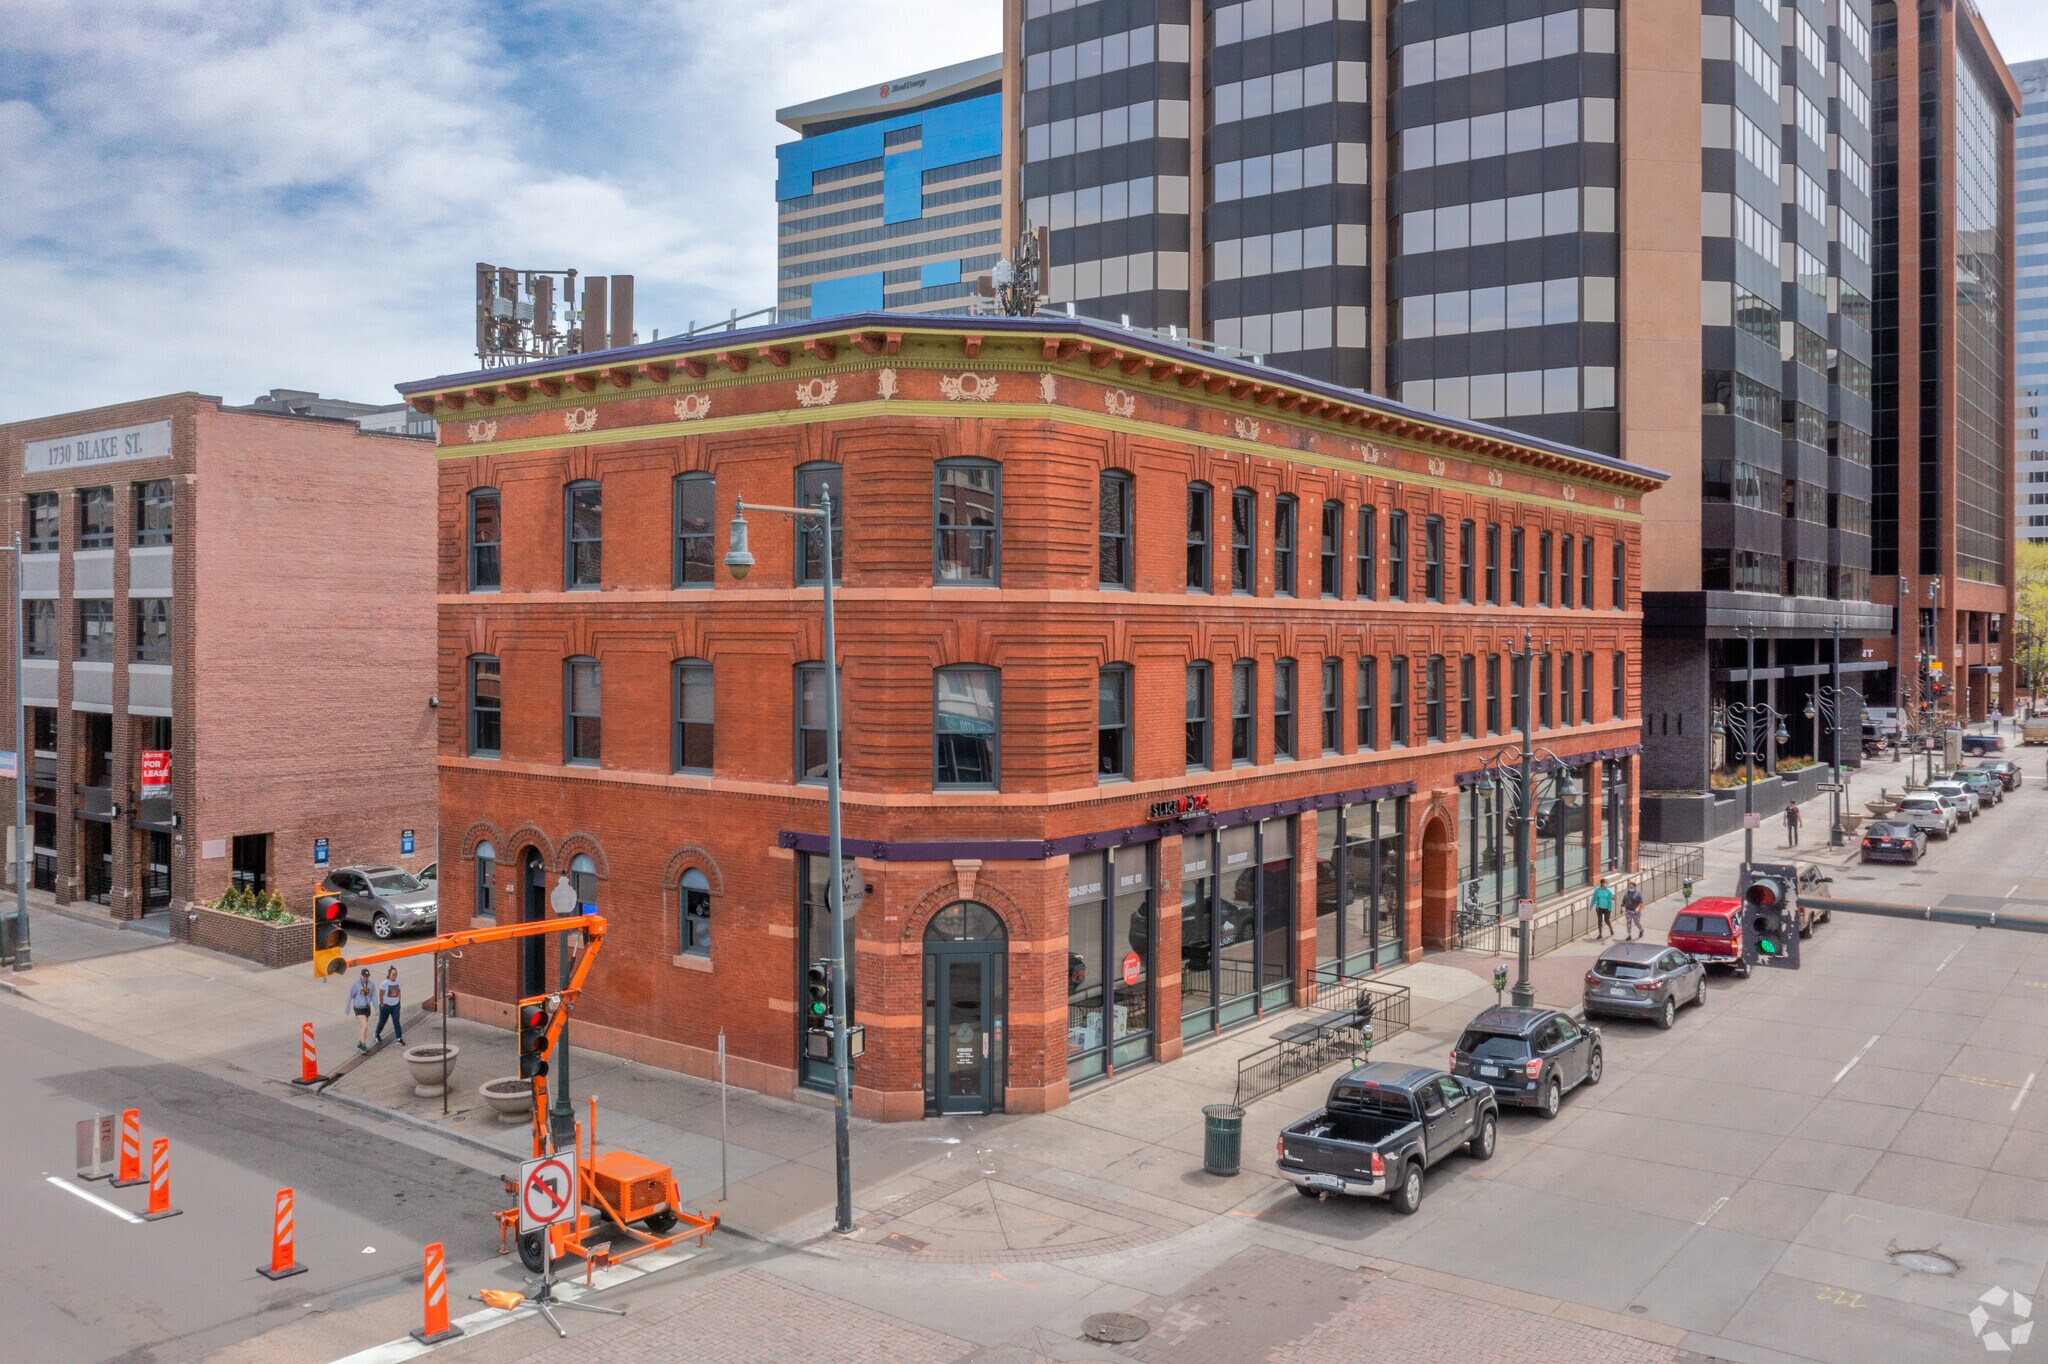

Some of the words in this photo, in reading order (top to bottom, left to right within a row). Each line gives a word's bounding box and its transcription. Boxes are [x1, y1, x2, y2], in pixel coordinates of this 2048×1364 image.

[48, 444, 72, 466] 1730
[76, 436, 118, 462] BLAKE
[125, 432, 143, 455] ST.
[143, 760, 161, 768] FOR
[143, 769, 169, 777] LEASE
